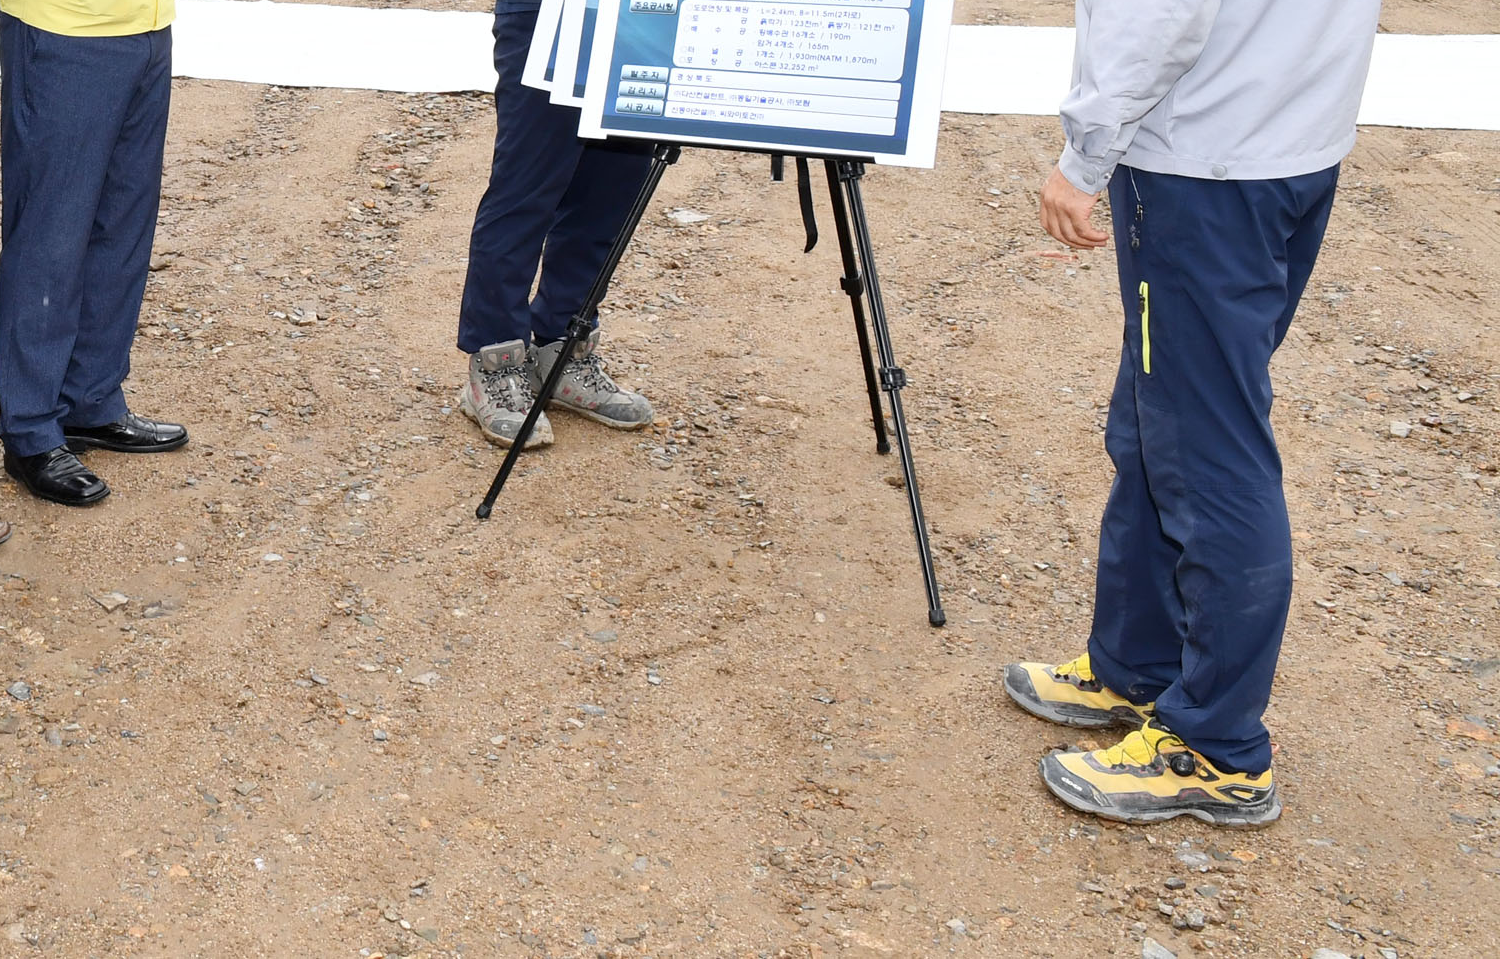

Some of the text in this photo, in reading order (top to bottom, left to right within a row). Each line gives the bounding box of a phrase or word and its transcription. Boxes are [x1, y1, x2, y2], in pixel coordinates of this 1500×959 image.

[634, 0, 674, 11] 주요공사량
[791, 30, 816, 39] 16개소
[829, 32, 851, 41] 190m
[774, 40, 794, 49] 4개소
[808, 42, 829, 51] 165m
[756, 50, 775, 59] 1개소
[788, 52, 842, 63] 1,930m(NATM
[845, 56, 877, 66] 1,870m)
[778, 62, 806, 72] 32,252
